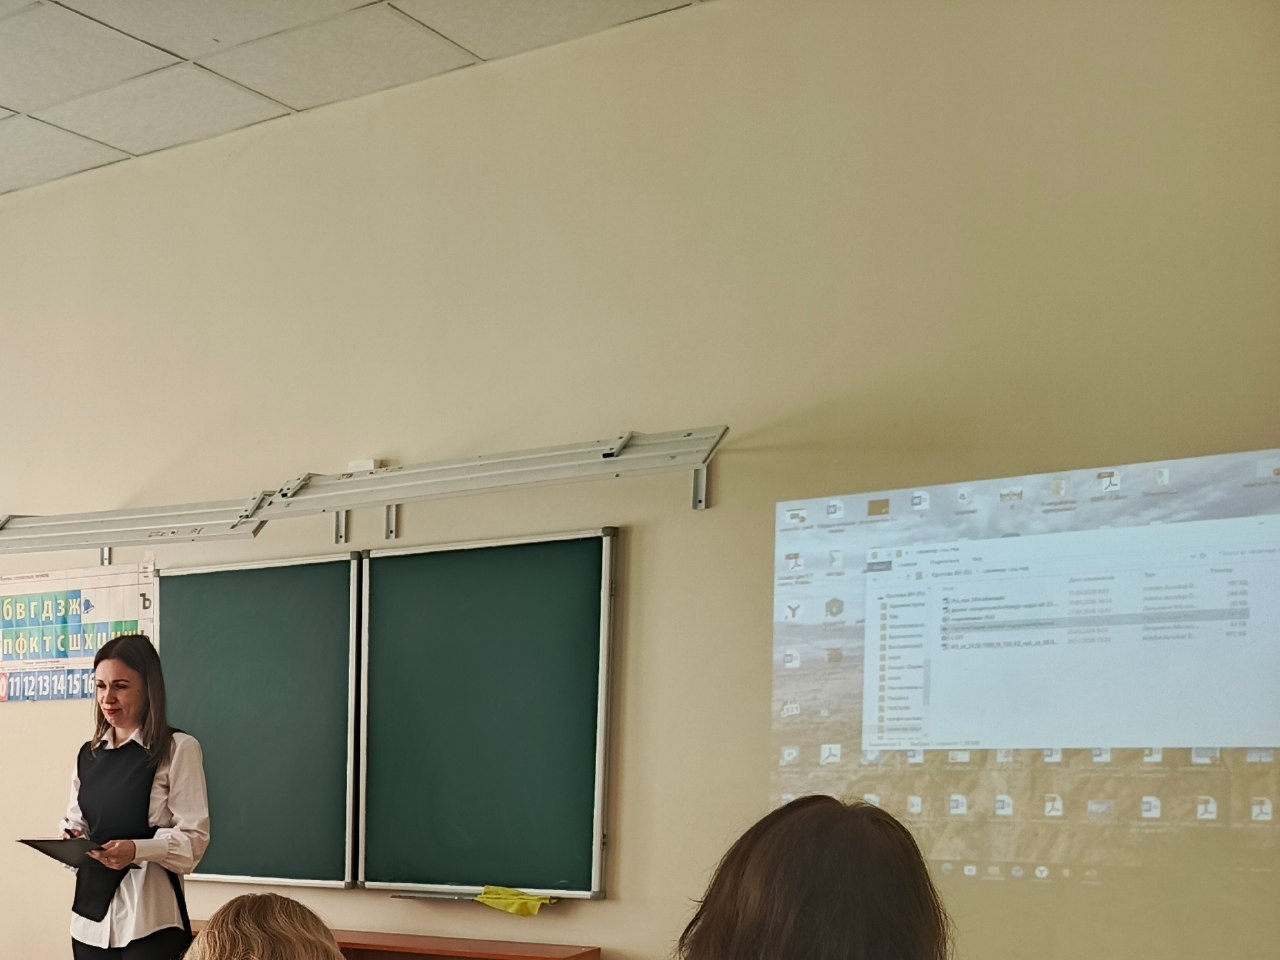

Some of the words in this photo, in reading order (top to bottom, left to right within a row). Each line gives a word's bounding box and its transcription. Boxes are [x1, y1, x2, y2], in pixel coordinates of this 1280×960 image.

[3, 598, 12, 620] б
[16, 602, 25, 620] в
[30, 601, 38, 618] г
[42, 600, 53, 621] д
[57, 600, 65, 616] з
[69, 598, 80, 615] ж
[4, 639, 12, 655] п
[16, 633, 27, 659] ф
[30, 637, 38, 653] к
[43, 636, 52, 652] т
[57, 635, 65, 651] с
[69, 634, 80, 651] ш
[84, 634, 93, 650] х
[9, 676, 20, 696] 11
[23, 676, 35, 696] 12
[38, 675, 50, 695] 13
[52, 674, 65, 695] 14
[67, 673, 80, 694] 15
[82, 673, 95, 694] 16
